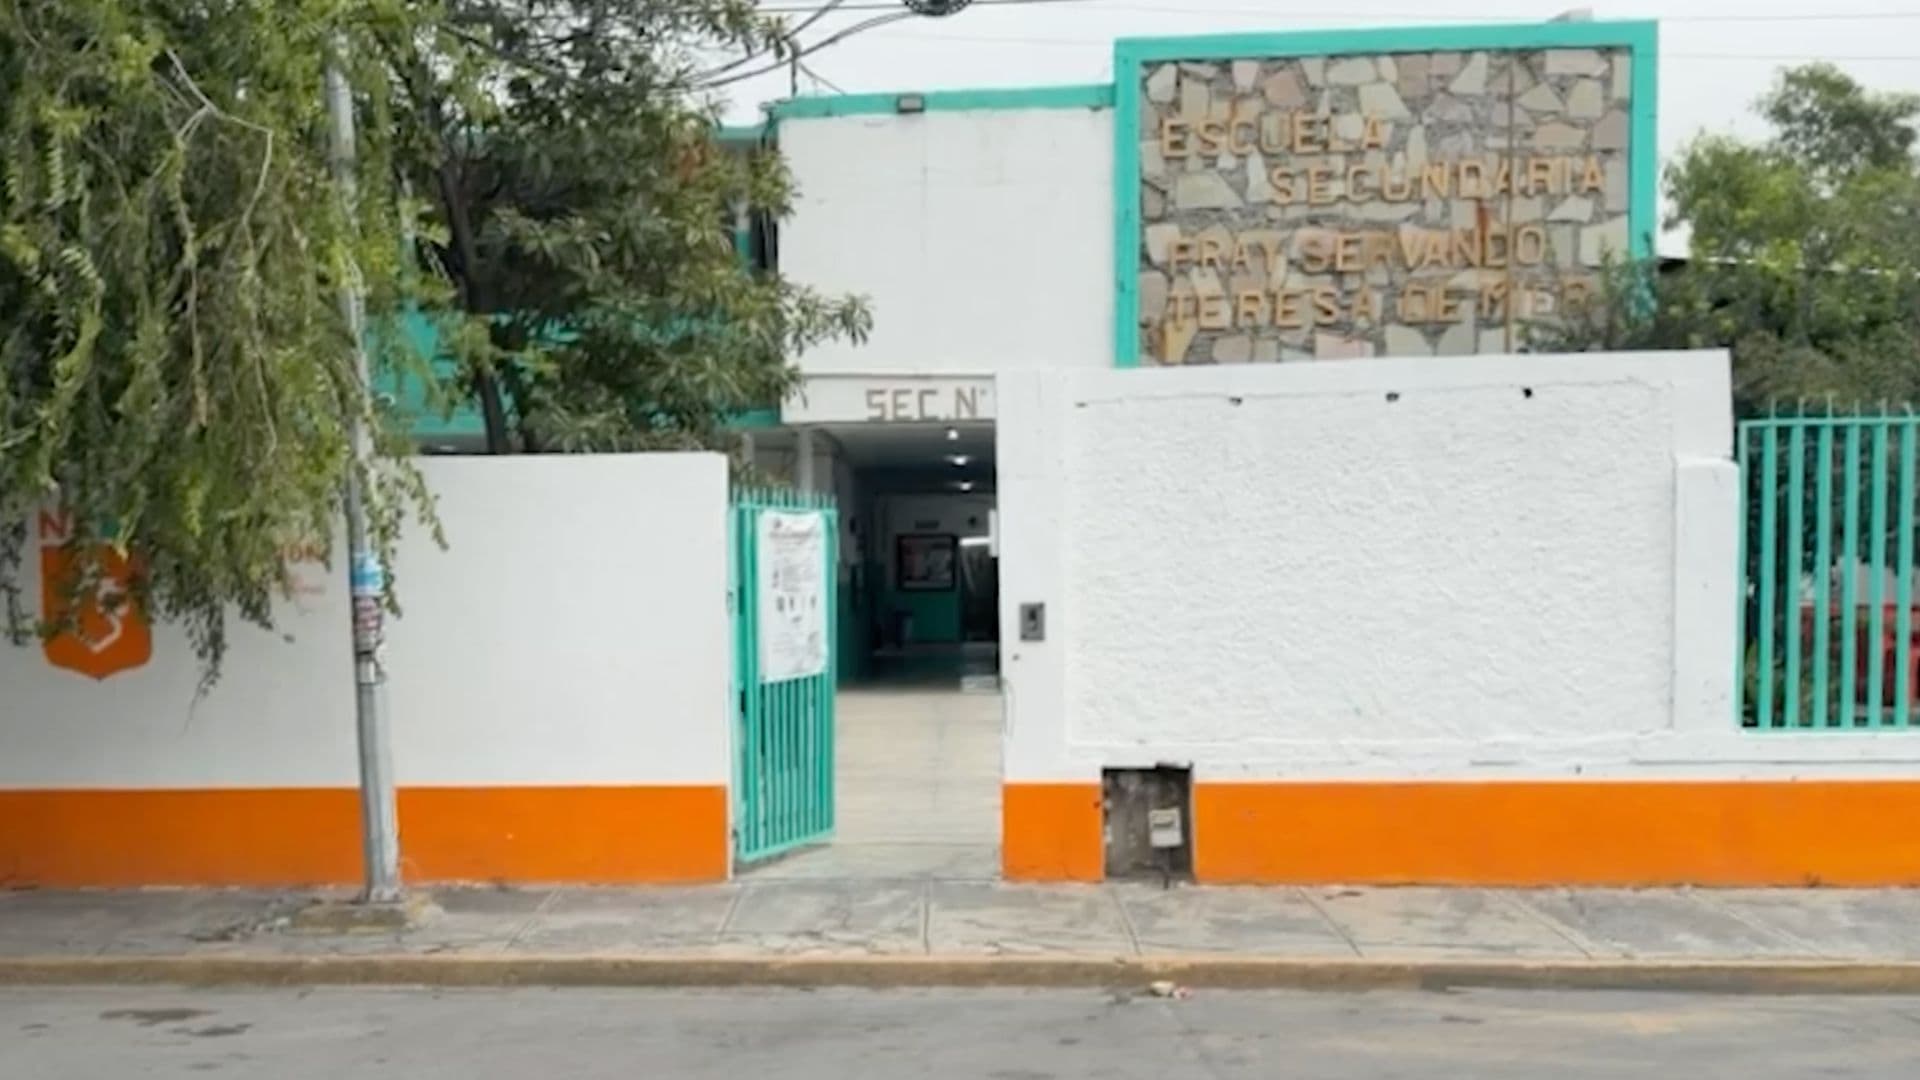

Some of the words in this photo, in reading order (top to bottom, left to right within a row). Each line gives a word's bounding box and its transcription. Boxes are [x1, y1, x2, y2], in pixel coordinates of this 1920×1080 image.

[1160, 111, 1386, 161] ESCUELA
[1271, 154, 1606, 206] SECUNDARIA
[1168, 231, 1283, 275] FRAY
[1303, 222, 1546, 273] SERVANDO
[1167, 284, 1374, 331] TERESA
[1401, 281, 1462, 324] DE
